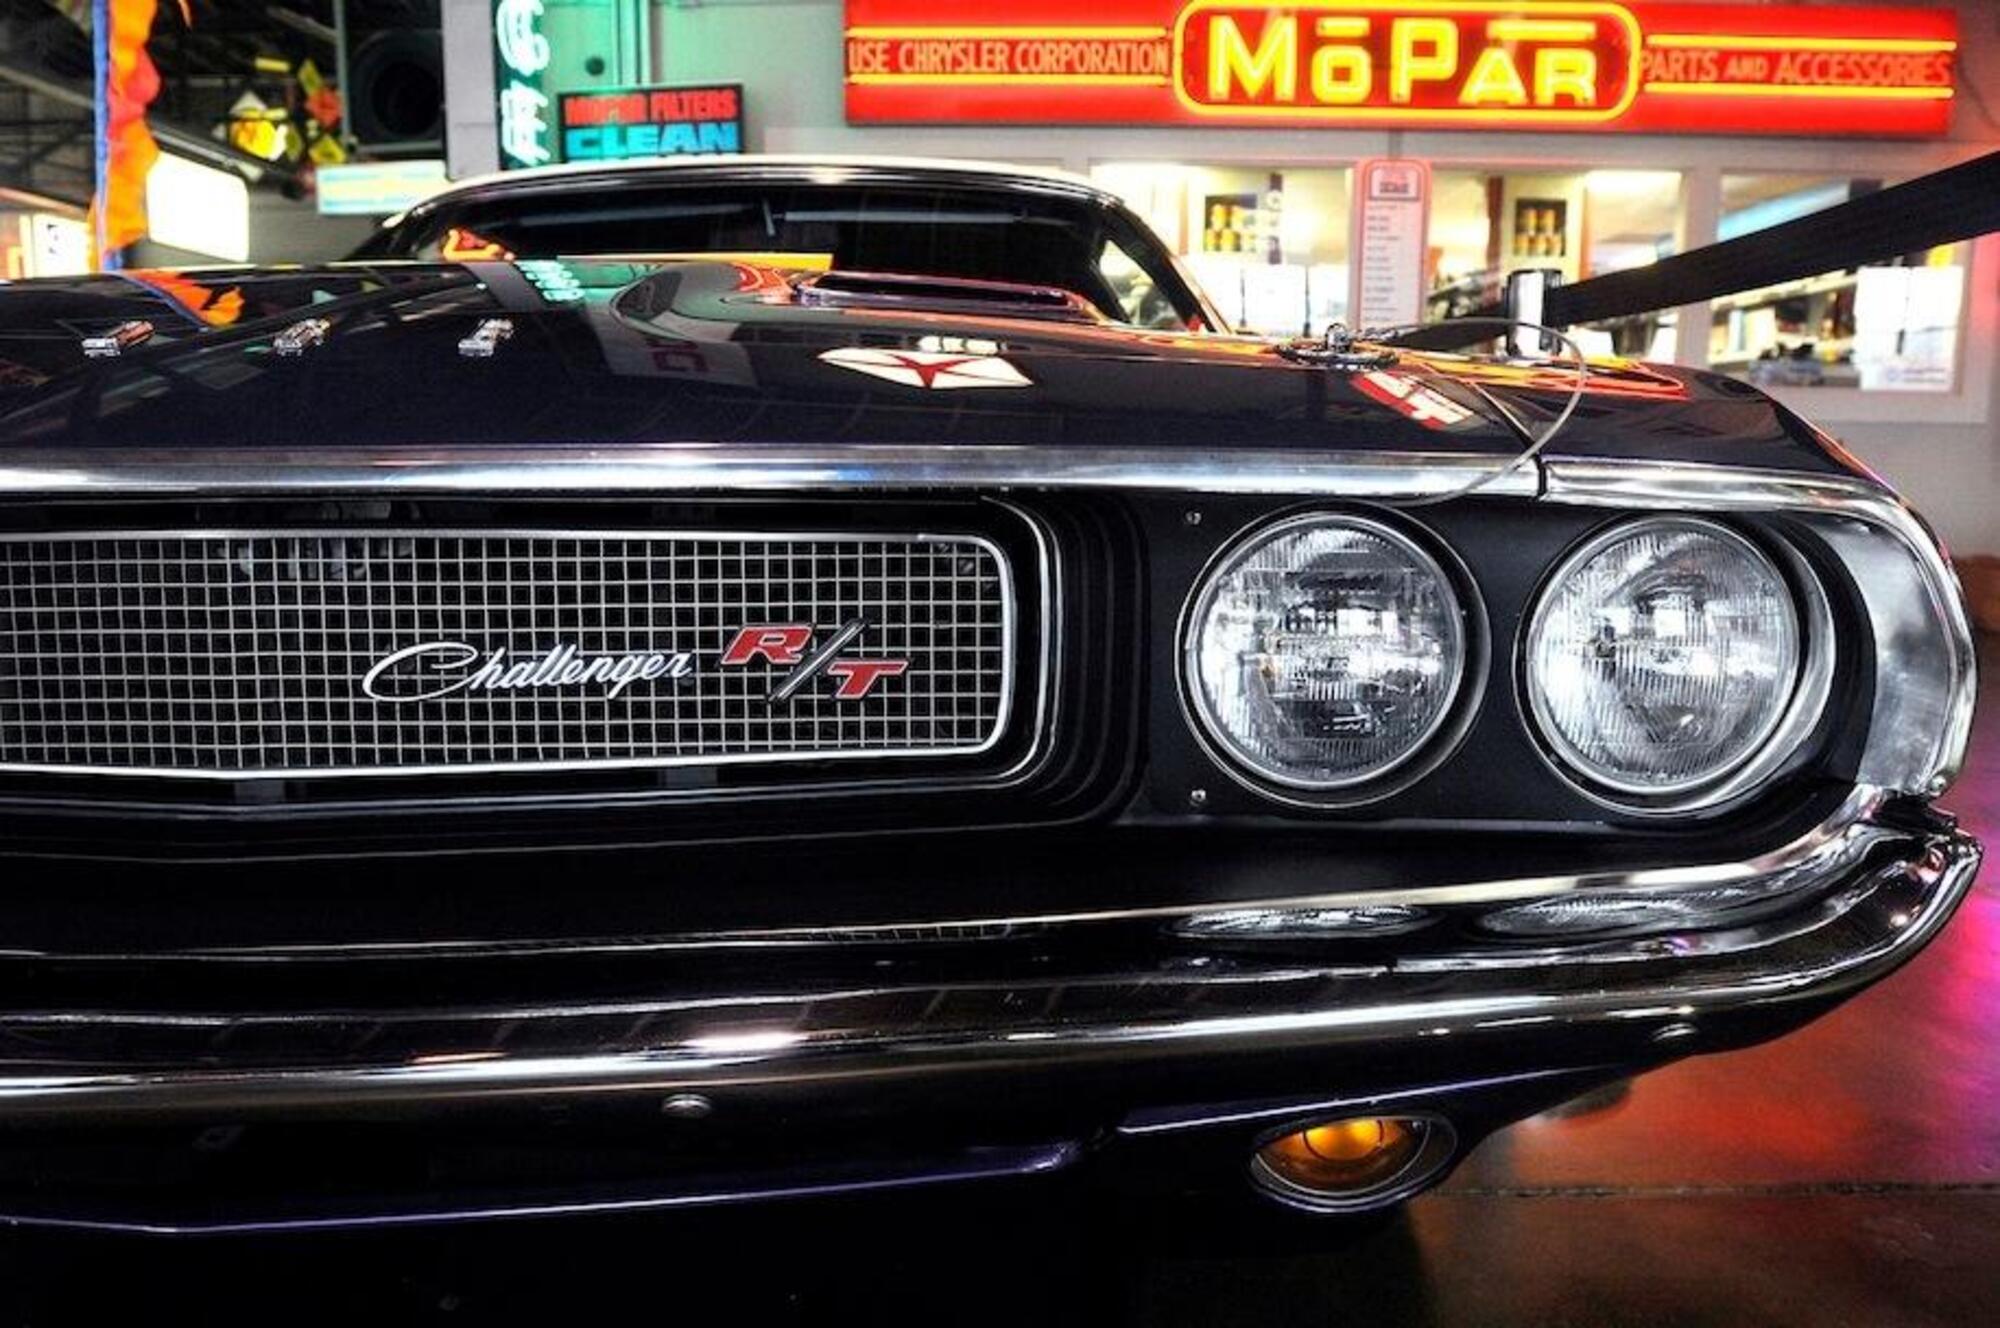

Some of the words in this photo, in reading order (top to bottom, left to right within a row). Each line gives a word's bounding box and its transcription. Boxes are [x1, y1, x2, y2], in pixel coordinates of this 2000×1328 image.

[849, 41, 889, 72] USE
[899, 41, 1009, 72] CHRYSLER
[1014, 41, 1169, 73] CORPORATION
[1640, 51, 1718, 81] PARTS
[1772, 52, 1951, 85] ACCESSORIES
[566, 121, 739, 159] CLEAN
[362, 641, 692, 702] Challenger
[720, 619, 910, 702] R/T
